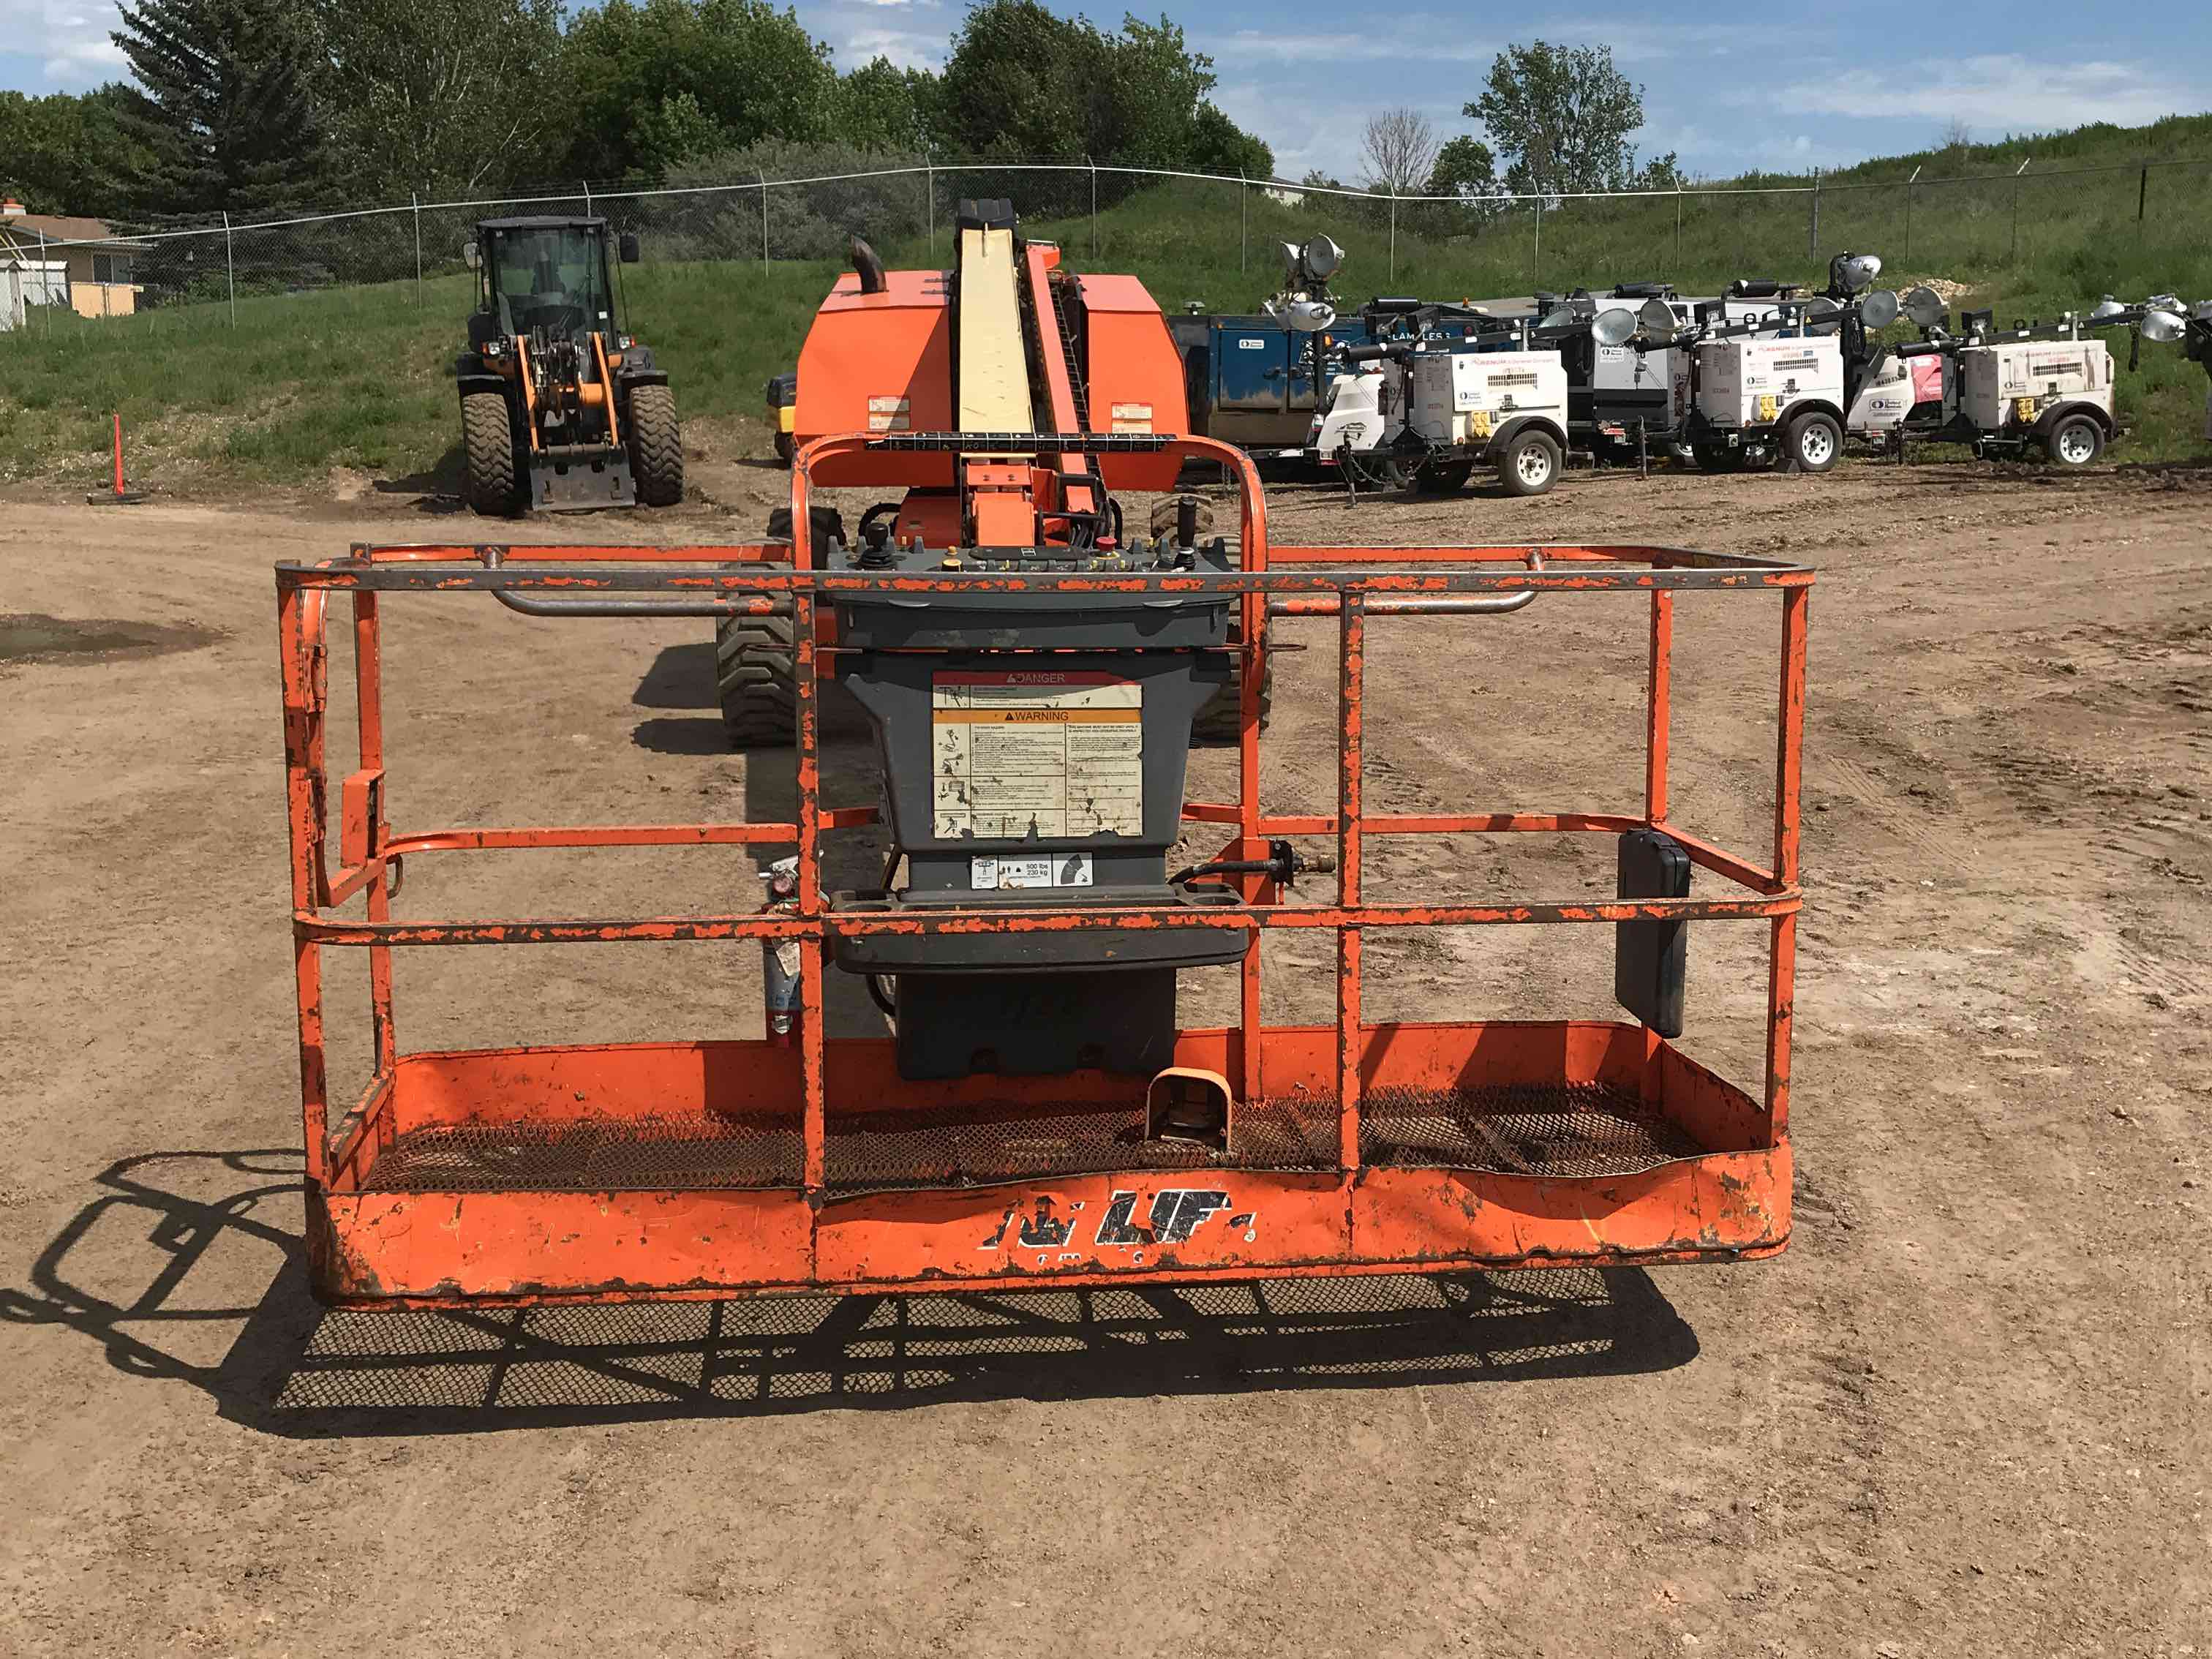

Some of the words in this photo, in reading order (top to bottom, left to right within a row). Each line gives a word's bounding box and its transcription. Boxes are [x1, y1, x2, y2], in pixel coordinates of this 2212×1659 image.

[1388, 332, 1451, 341] LAMLES
[1016, 673, 1065, 683] DANGER
[1014, 711, 1069, 721] WARNING
